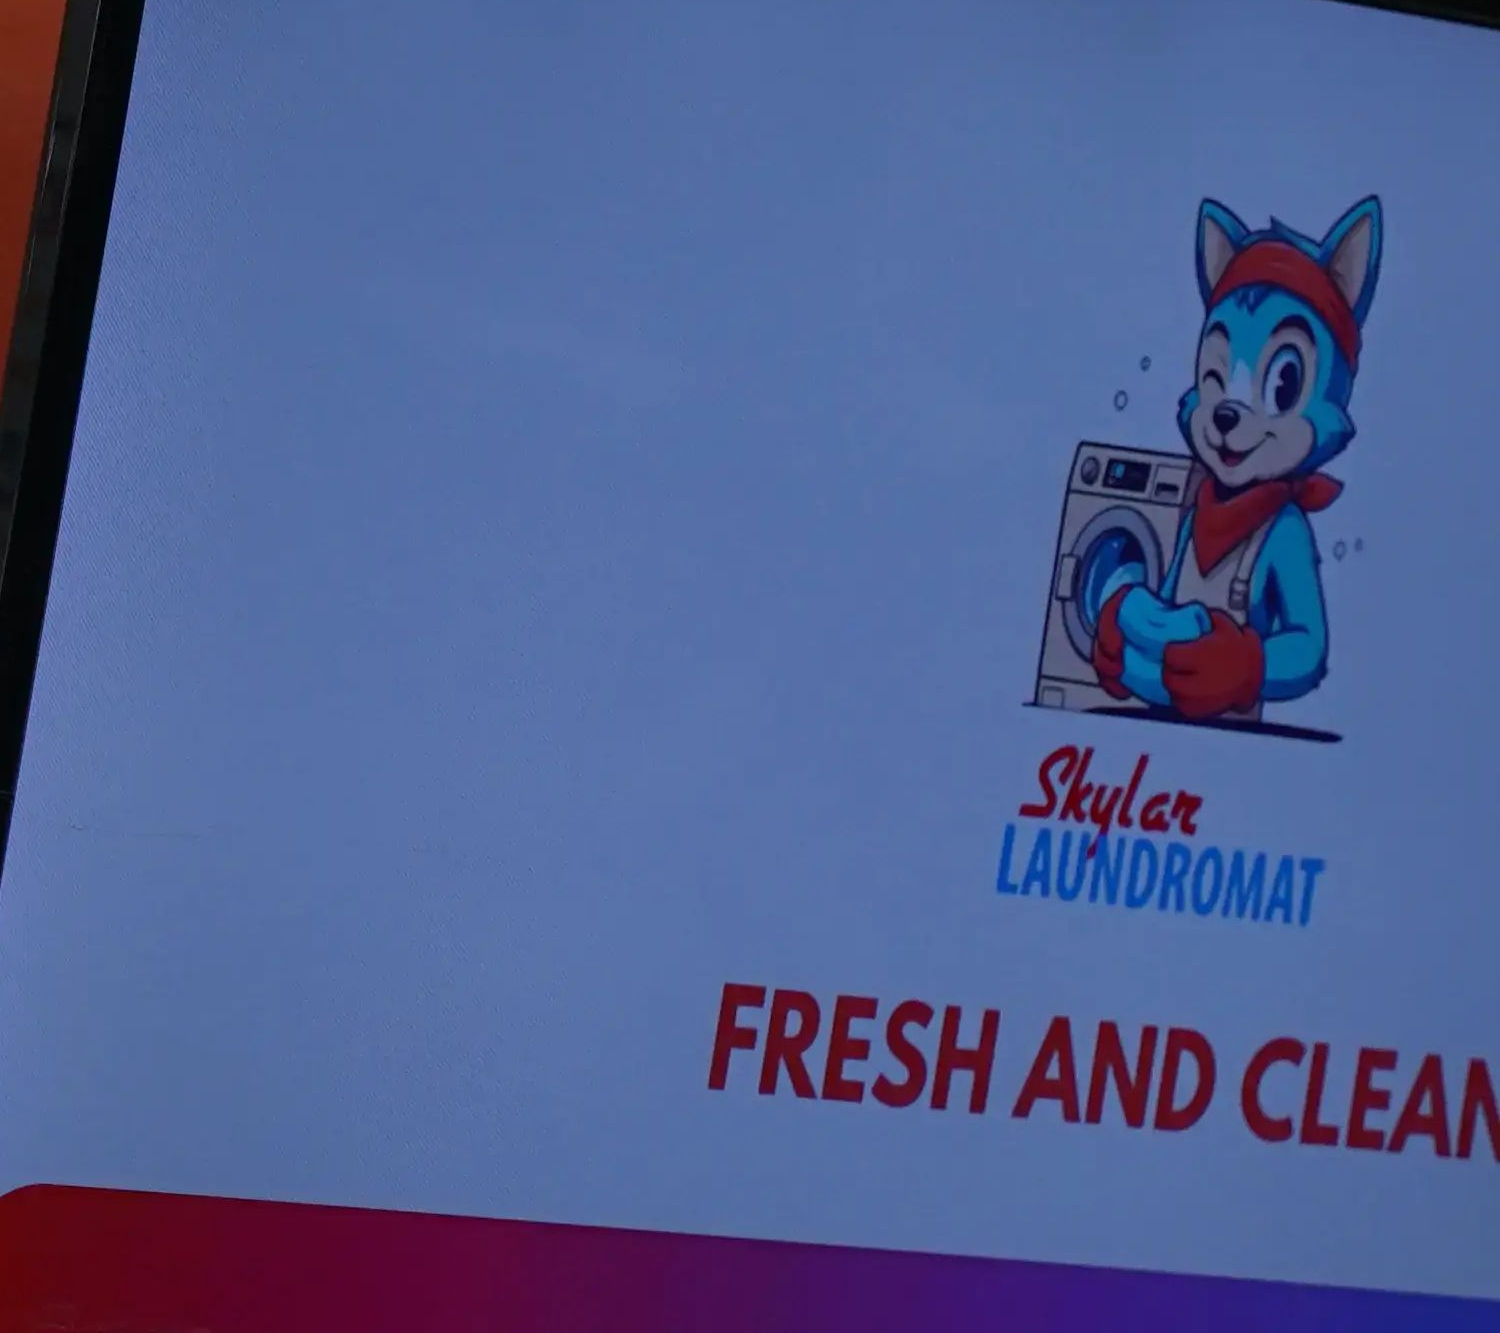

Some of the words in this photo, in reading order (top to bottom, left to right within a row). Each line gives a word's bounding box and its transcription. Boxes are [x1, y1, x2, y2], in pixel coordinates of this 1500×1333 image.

[1018, 743, 1205, 861] Skylar
[995, 822, 1327, 929] LAUNDROMAT
[706, 981, 1001, 1117] FRESH
[1010, 1014, 1218, 1134] AND
